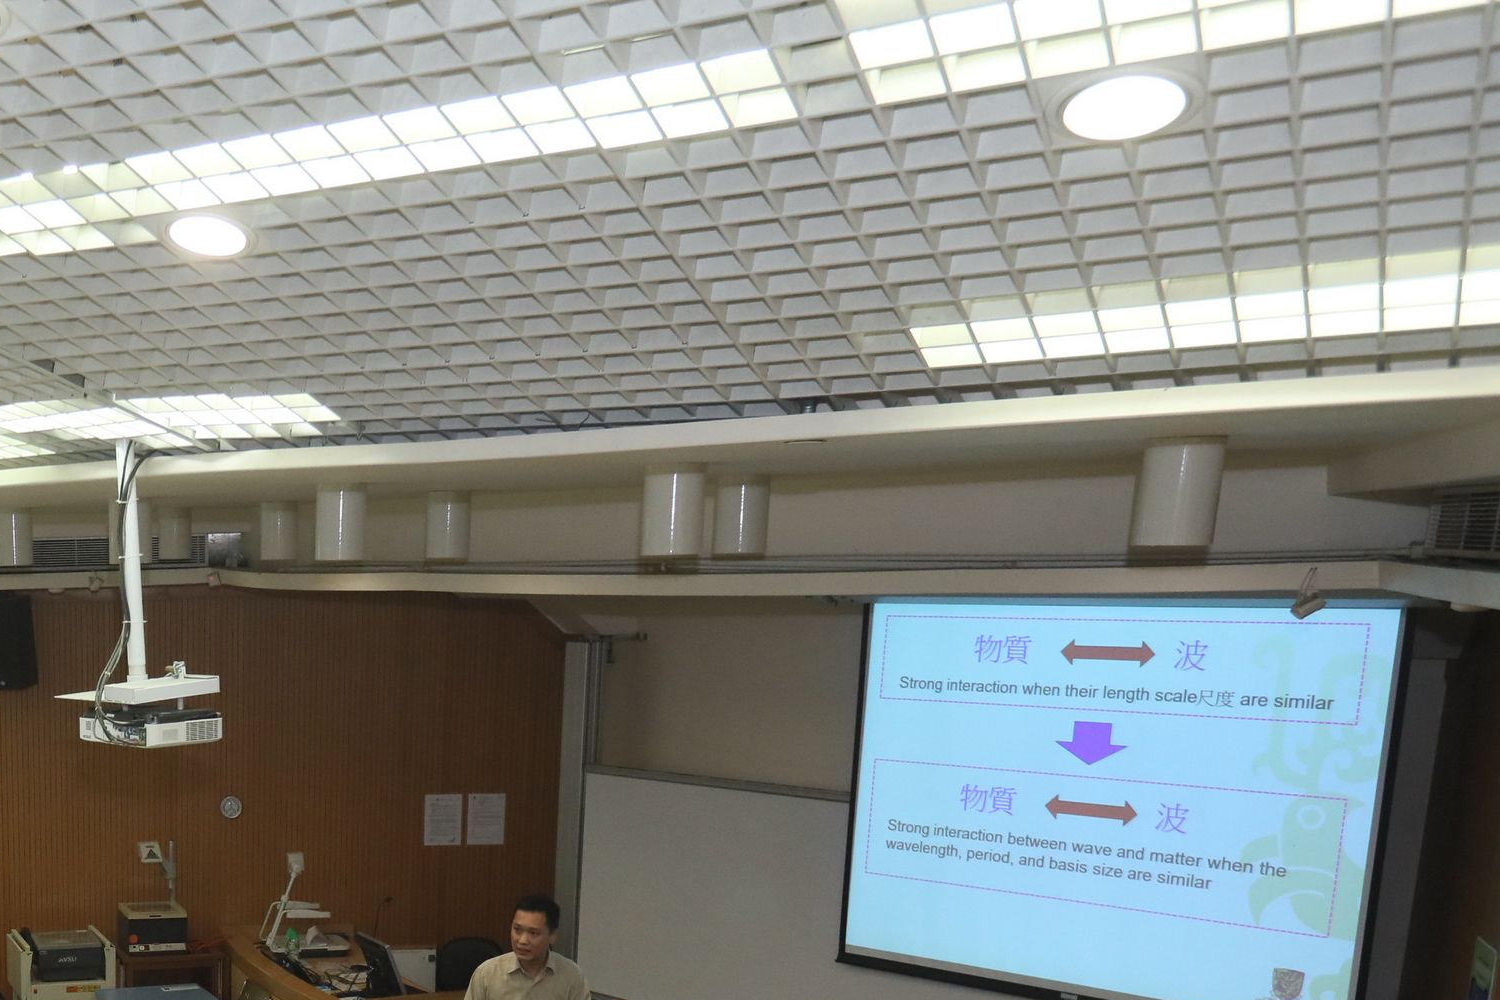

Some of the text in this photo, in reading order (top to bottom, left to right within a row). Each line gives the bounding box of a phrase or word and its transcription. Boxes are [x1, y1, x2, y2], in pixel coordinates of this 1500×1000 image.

[974, 634, 1209, 672] 物質 波
[899, 675, 943, 694] Strong
[946, 677, 1018, 695] interaction
[1021, 681, 1060, 697] when
[1065, 683, 1100, 699] their
[1102, 685, 1150, 704] length
[1240, 693, 1269, 708] are
[1273, 694, 1336, 710] similar
[960, 783, 1190, 835] 物質 波
[885, 838, 1213, 890] wavelength, period, and basis size are similar
[887, 818, 1287, 878] Strong interaction between wave and matter when the
